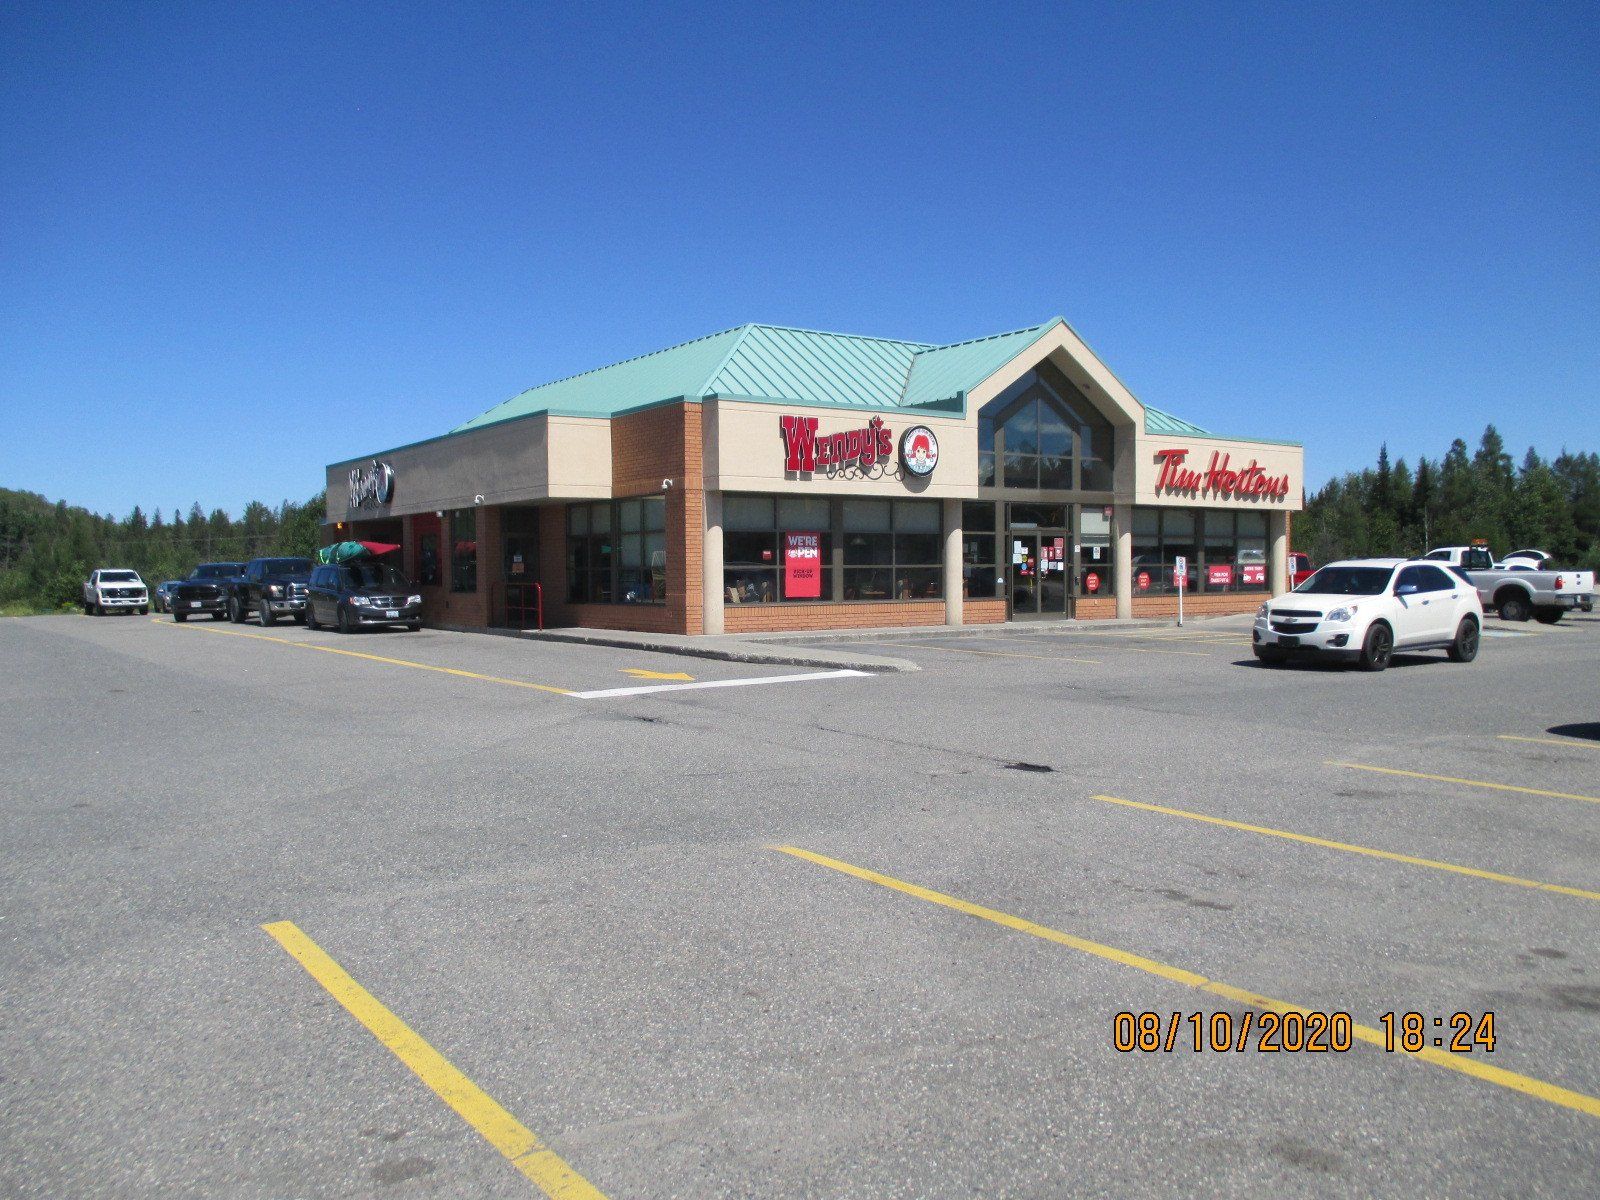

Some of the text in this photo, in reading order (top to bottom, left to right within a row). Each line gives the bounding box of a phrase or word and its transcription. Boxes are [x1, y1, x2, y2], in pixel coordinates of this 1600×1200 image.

[780, 415, 893, 472] Wendy's
[1155, 449, 1289, 497] Tim Hortons
[787, 536, 818, 546] WE'RE
